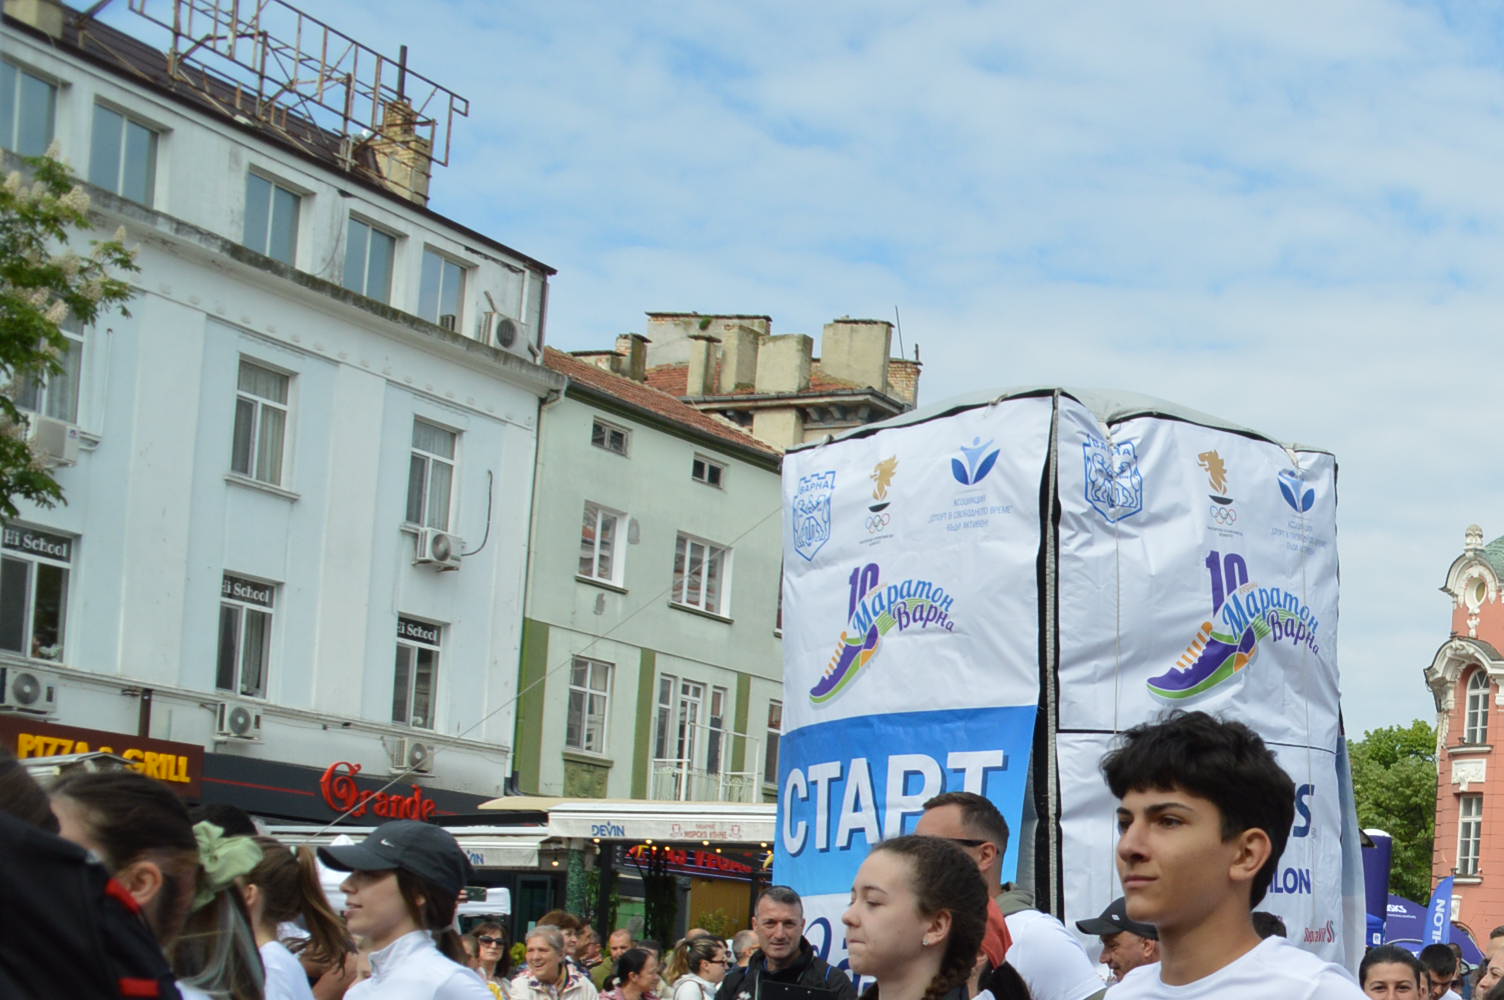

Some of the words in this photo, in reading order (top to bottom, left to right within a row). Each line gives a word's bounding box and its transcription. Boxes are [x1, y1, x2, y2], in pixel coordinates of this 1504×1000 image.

[23, 534, 67, 558] School
[233, 582, 269, 603] School
[852, 579, 954, 638] Маратон
[407, 623, 438, 642] School
[892, 601, 955, 632] Варна
[1222, 587, 1319, 641] Маратон
[1266, 609, 1320, 656] Варна
[320, 761, 437, 822] Grande
[782, 749, 1004, 854] СТАРТ
[591, 823, 625, 837] DEVIN
